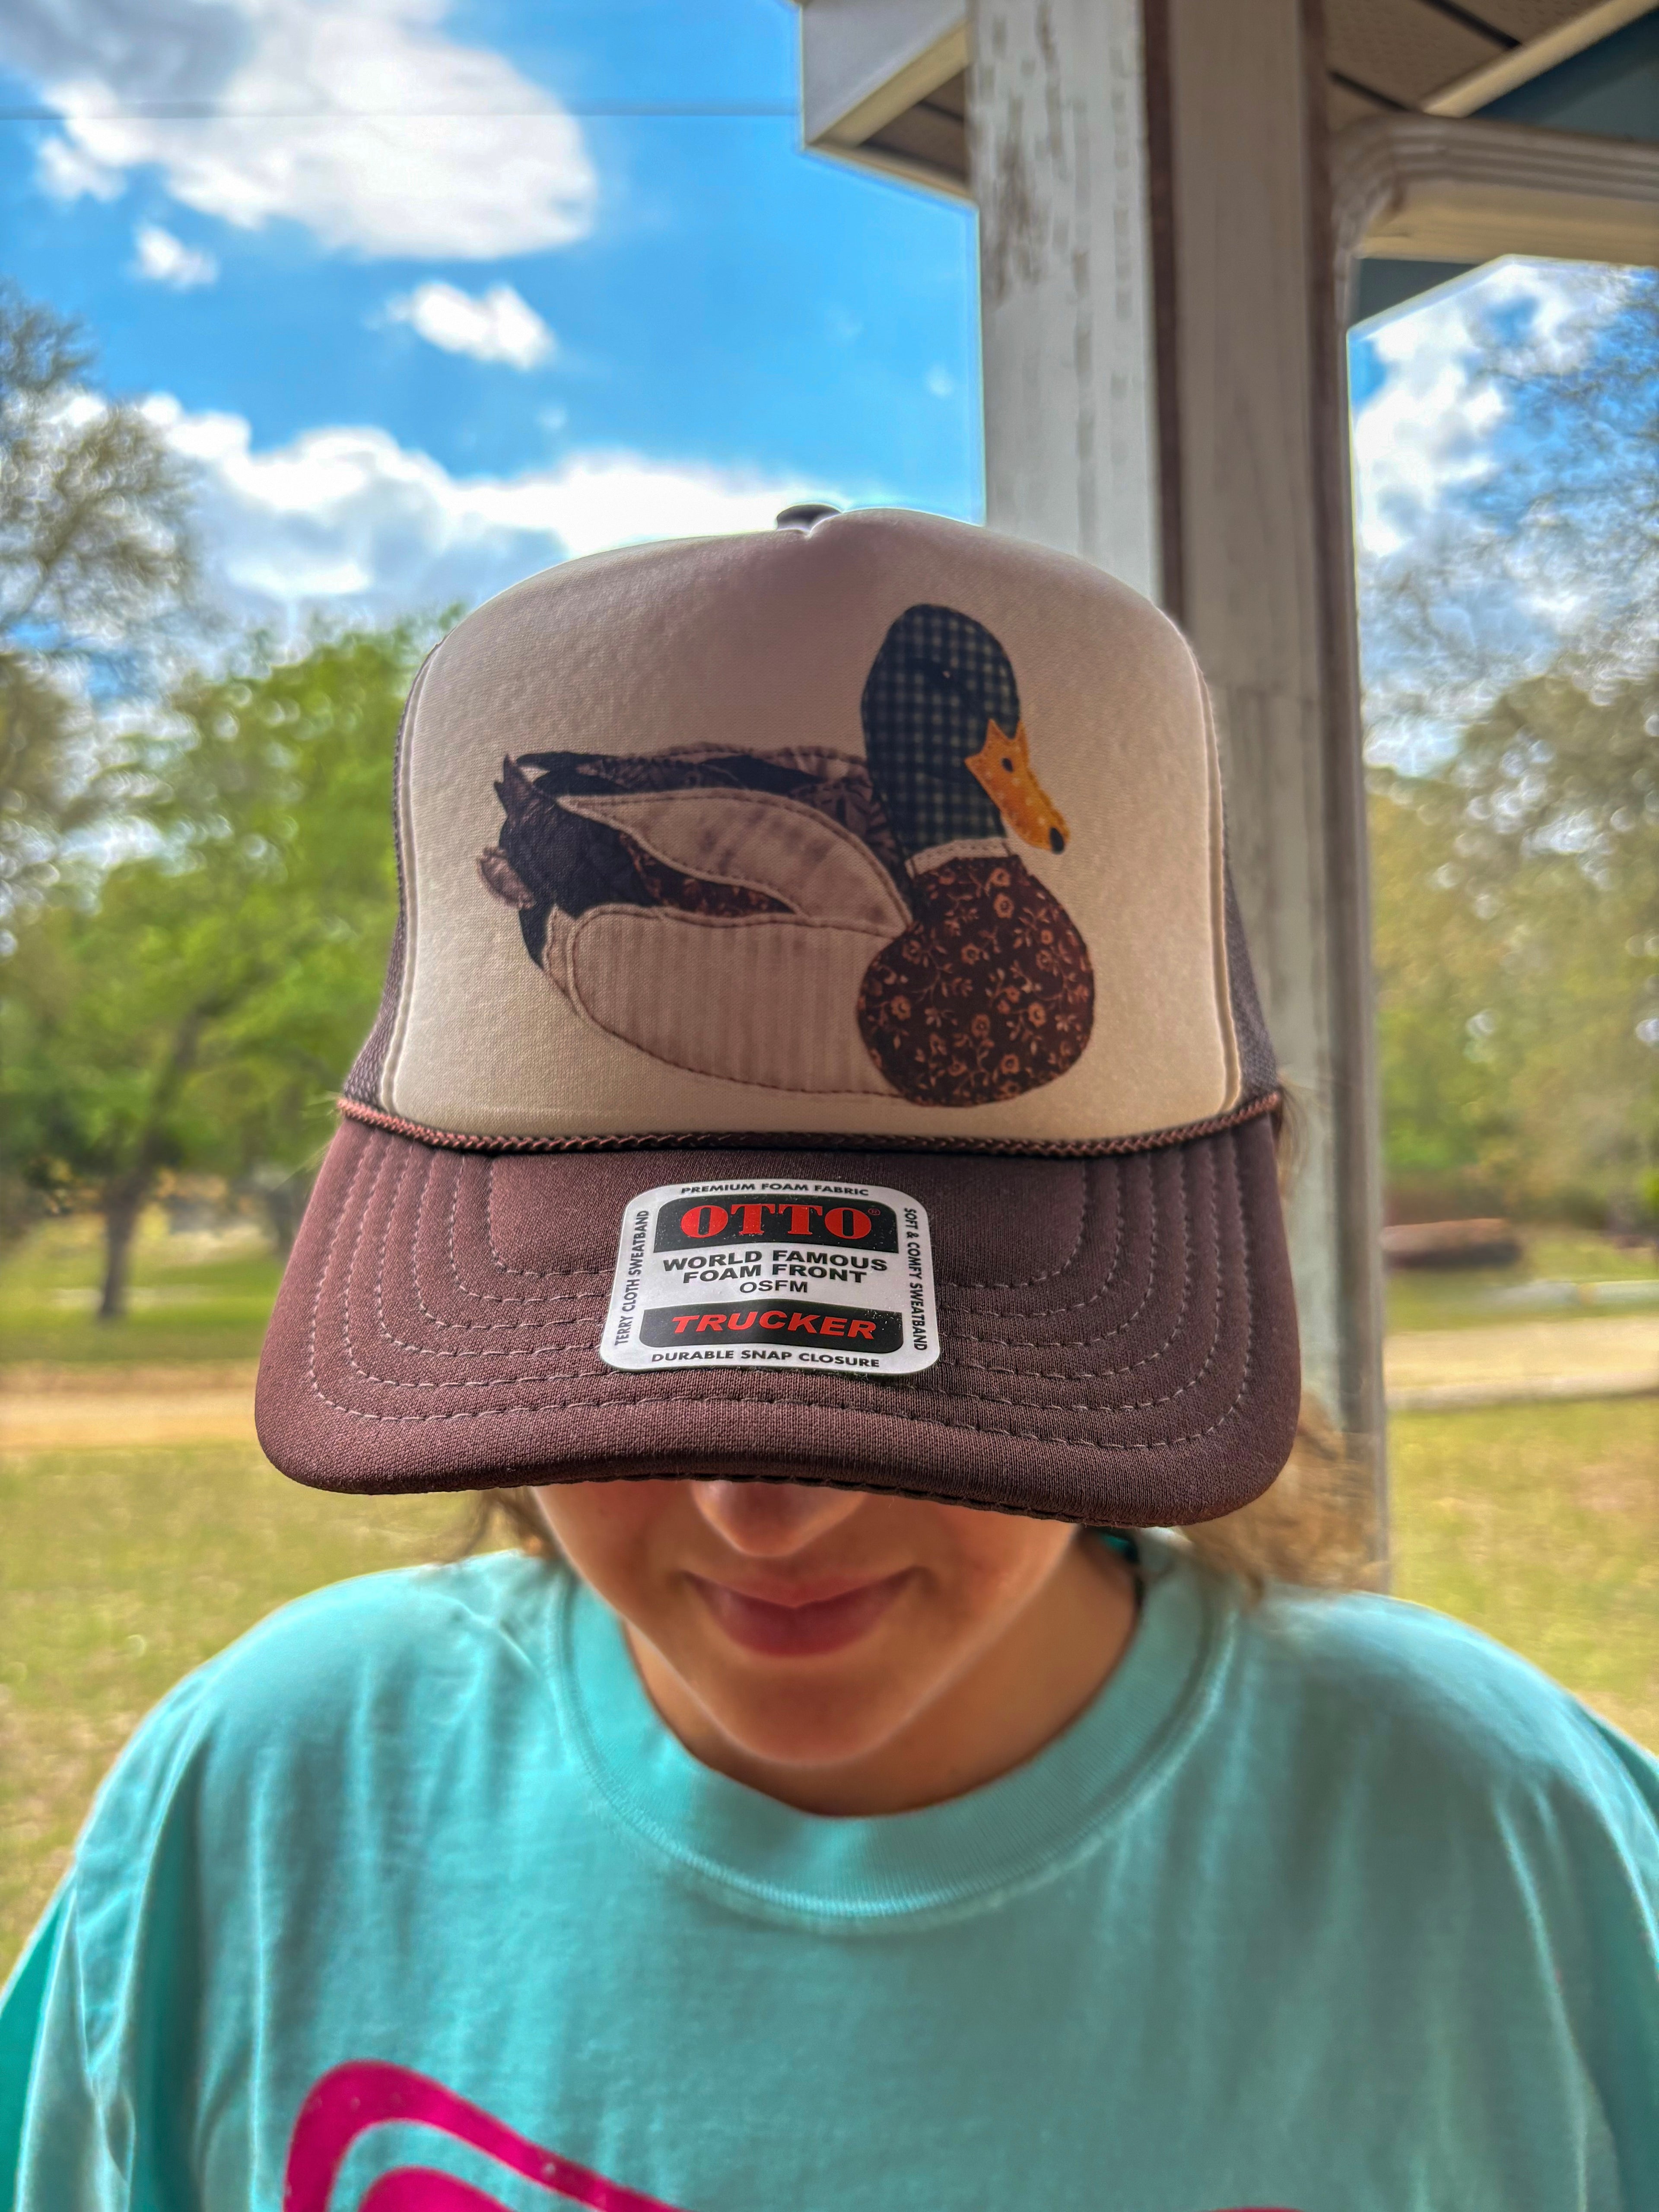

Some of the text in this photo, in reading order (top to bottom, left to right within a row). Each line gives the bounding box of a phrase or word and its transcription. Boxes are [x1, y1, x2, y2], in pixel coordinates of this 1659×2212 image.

[681, 1184, 755, 1194] PREMIUM
[815, 1185, 869, 1196] FABRIC
[680, 1204, 871, 1239] OTTO
[904, 1208, 918, 1230] SOFT
[663, 1250, 887, 1271] WORLD FAMOUS
[907, 1242, 922, 1280] COMFY
[614, 1210, 648, 1346] TERRY CLOTH SWEATBAND
[683, 1264, 867, 1284] FOAM FRONT
[740, 1280, 807, 1293] OSFM
[672, 1310, 876, 1340] TRUCKER
[909, 1282, 927, 1351] SWEATBAND
[652, 1350, 879, 1367] DURABLE SNAP CLOSURE
